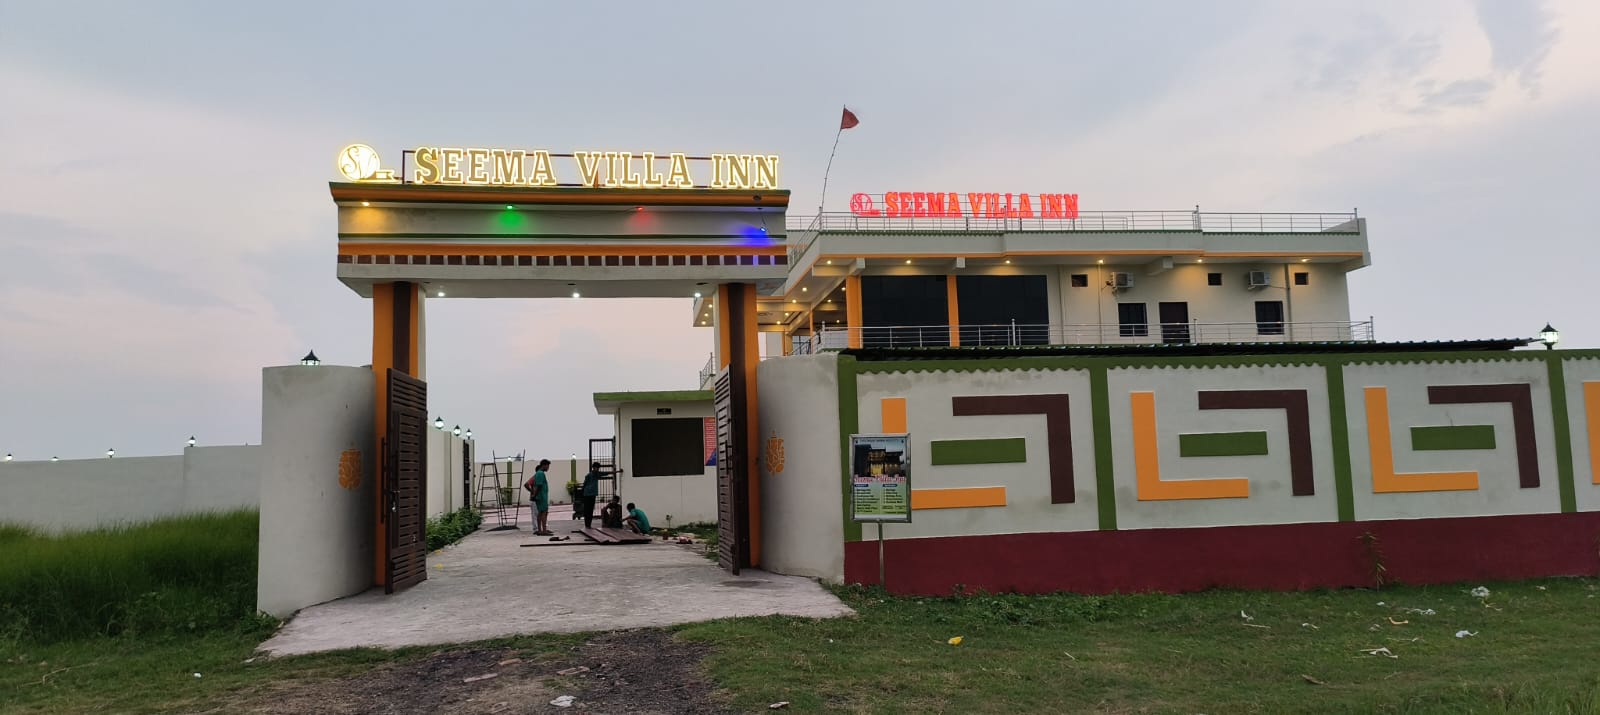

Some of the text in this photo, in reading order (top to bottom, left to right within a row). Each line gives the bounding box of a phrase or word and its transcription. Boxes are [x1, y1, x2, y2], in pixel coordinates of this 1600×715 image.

[414, 147, 779, 189] SEEMA VILLA INN
[885, 192, 1079, 218] SEEMA VILLA INN
